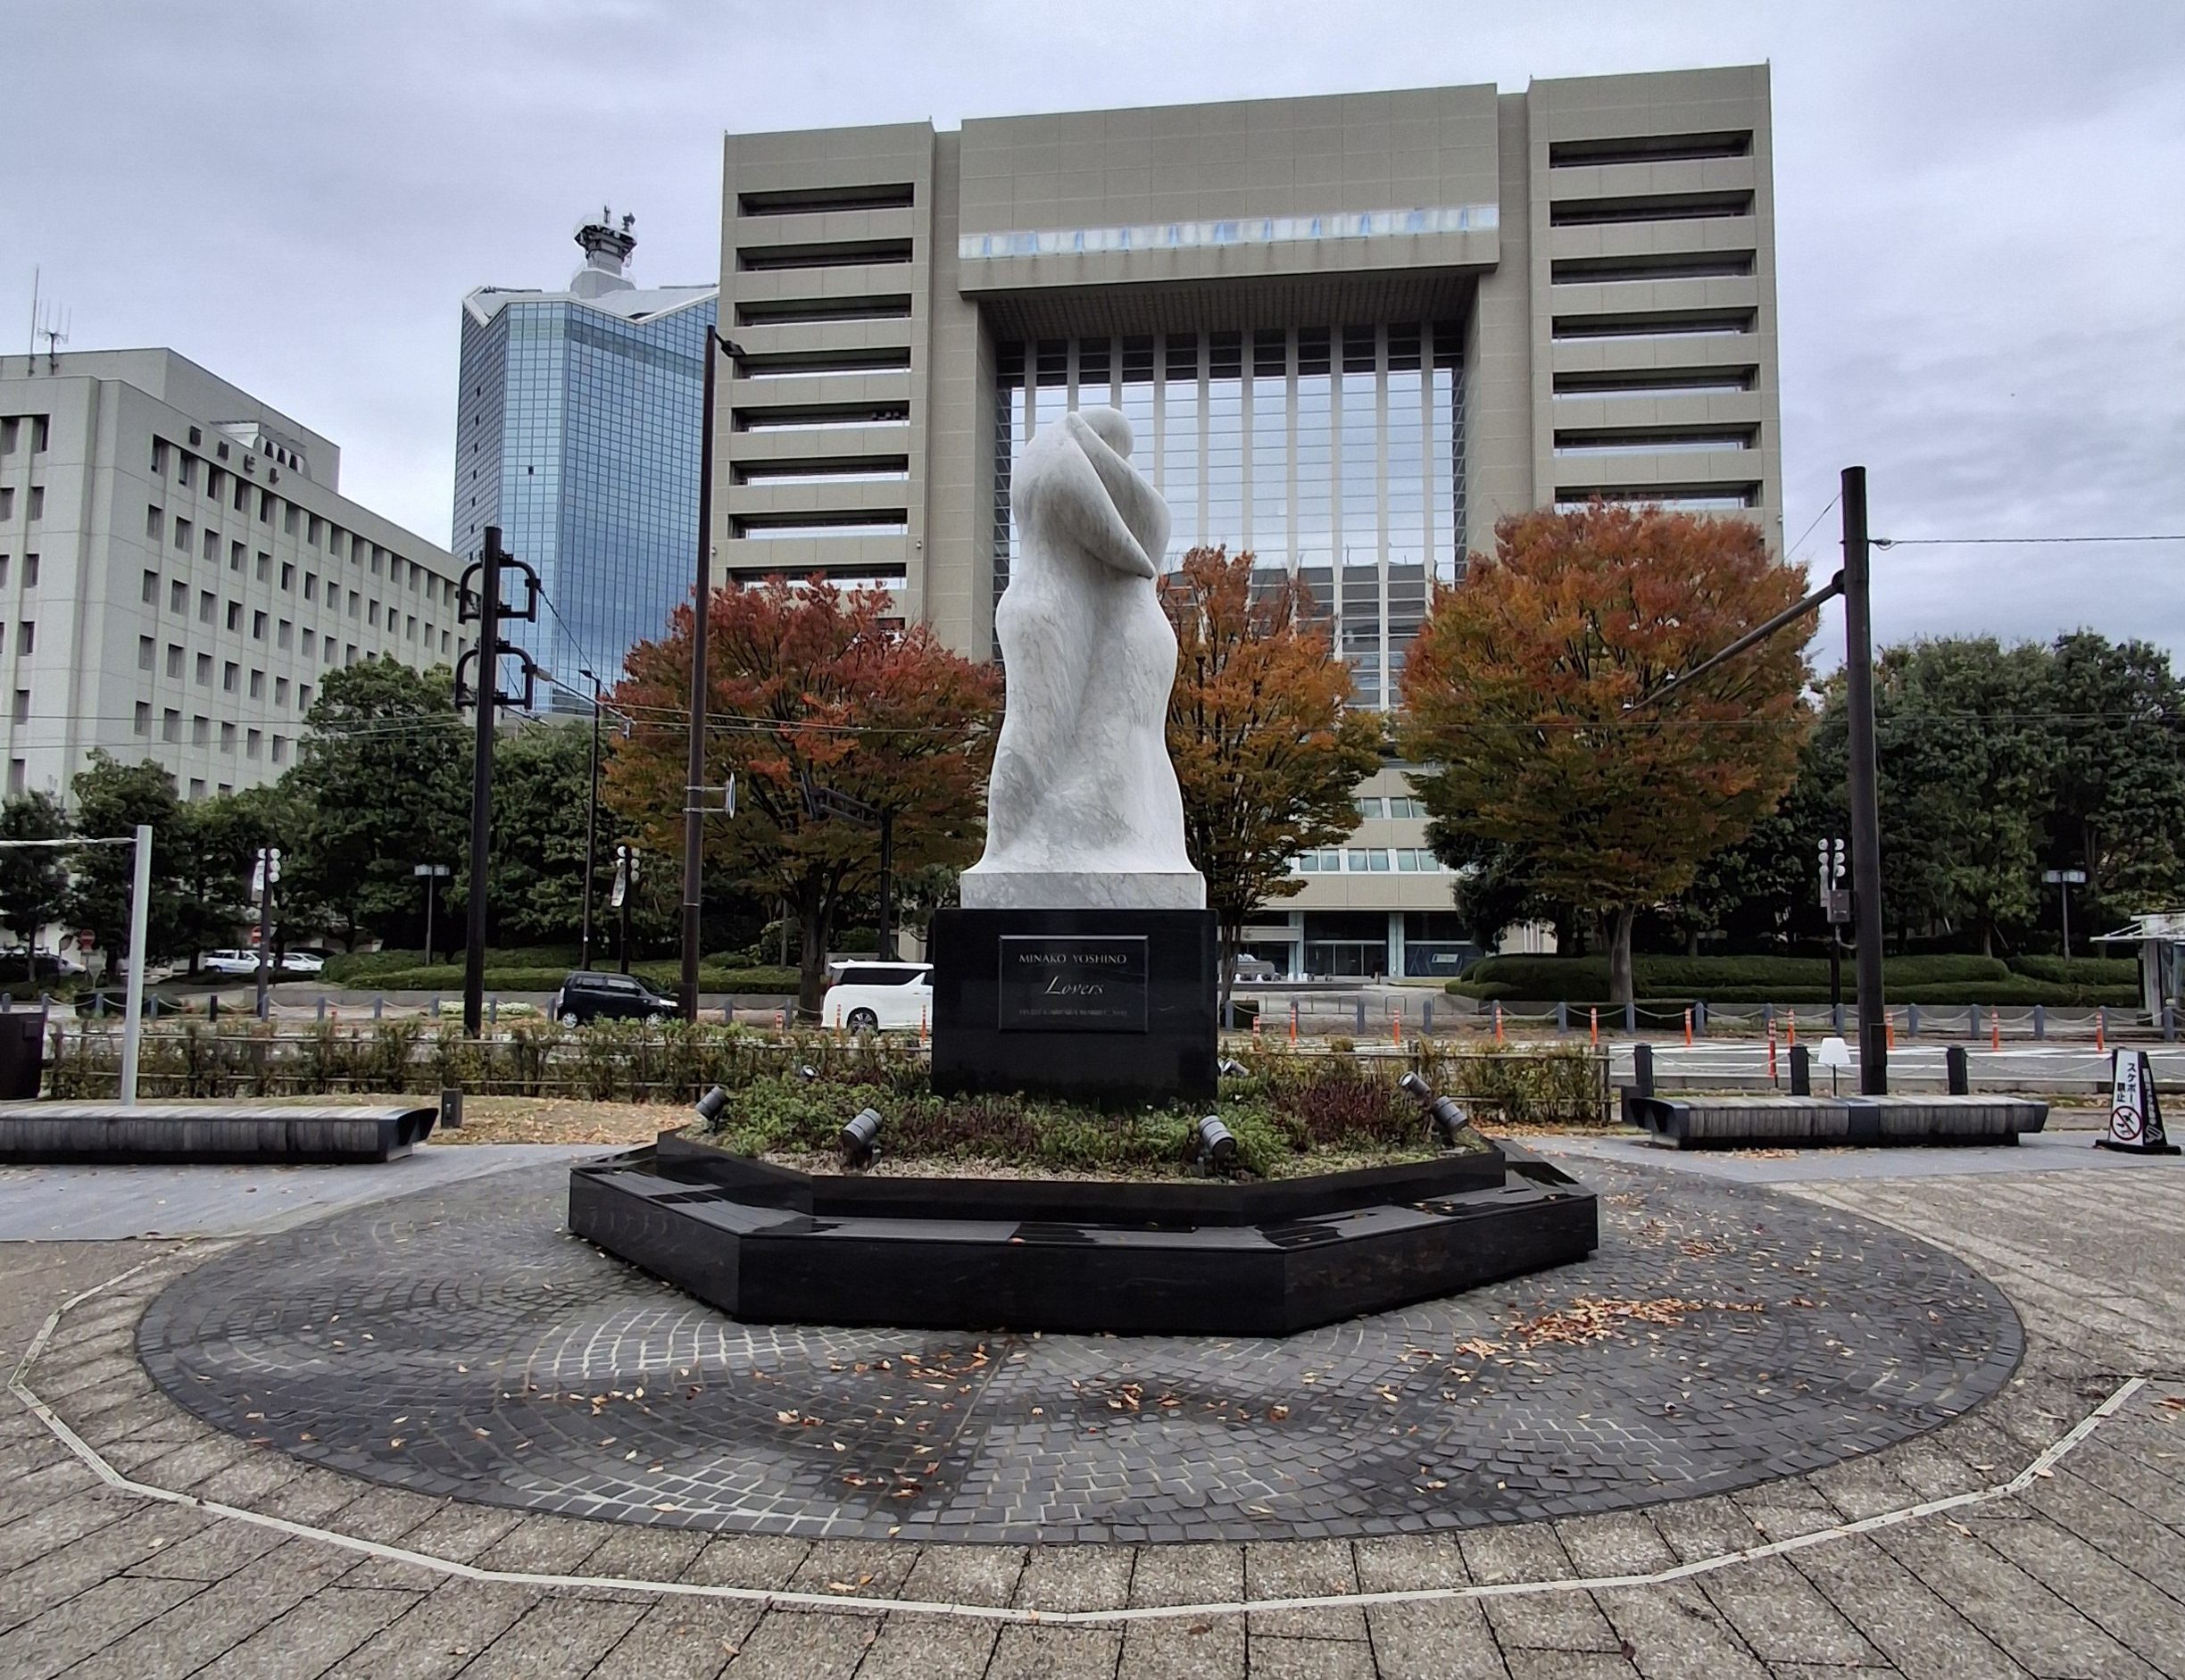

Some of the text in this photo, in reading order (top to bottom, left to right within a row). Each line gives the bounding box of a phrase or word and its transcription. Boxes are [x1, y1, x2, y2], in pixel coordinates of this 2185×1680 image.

[1018, 954, 1127, 964] MINAKO YOSHINO
[1044, 975, 1104, 995] Lovers
[2127, 1062, 2137, 1103] スケボー
